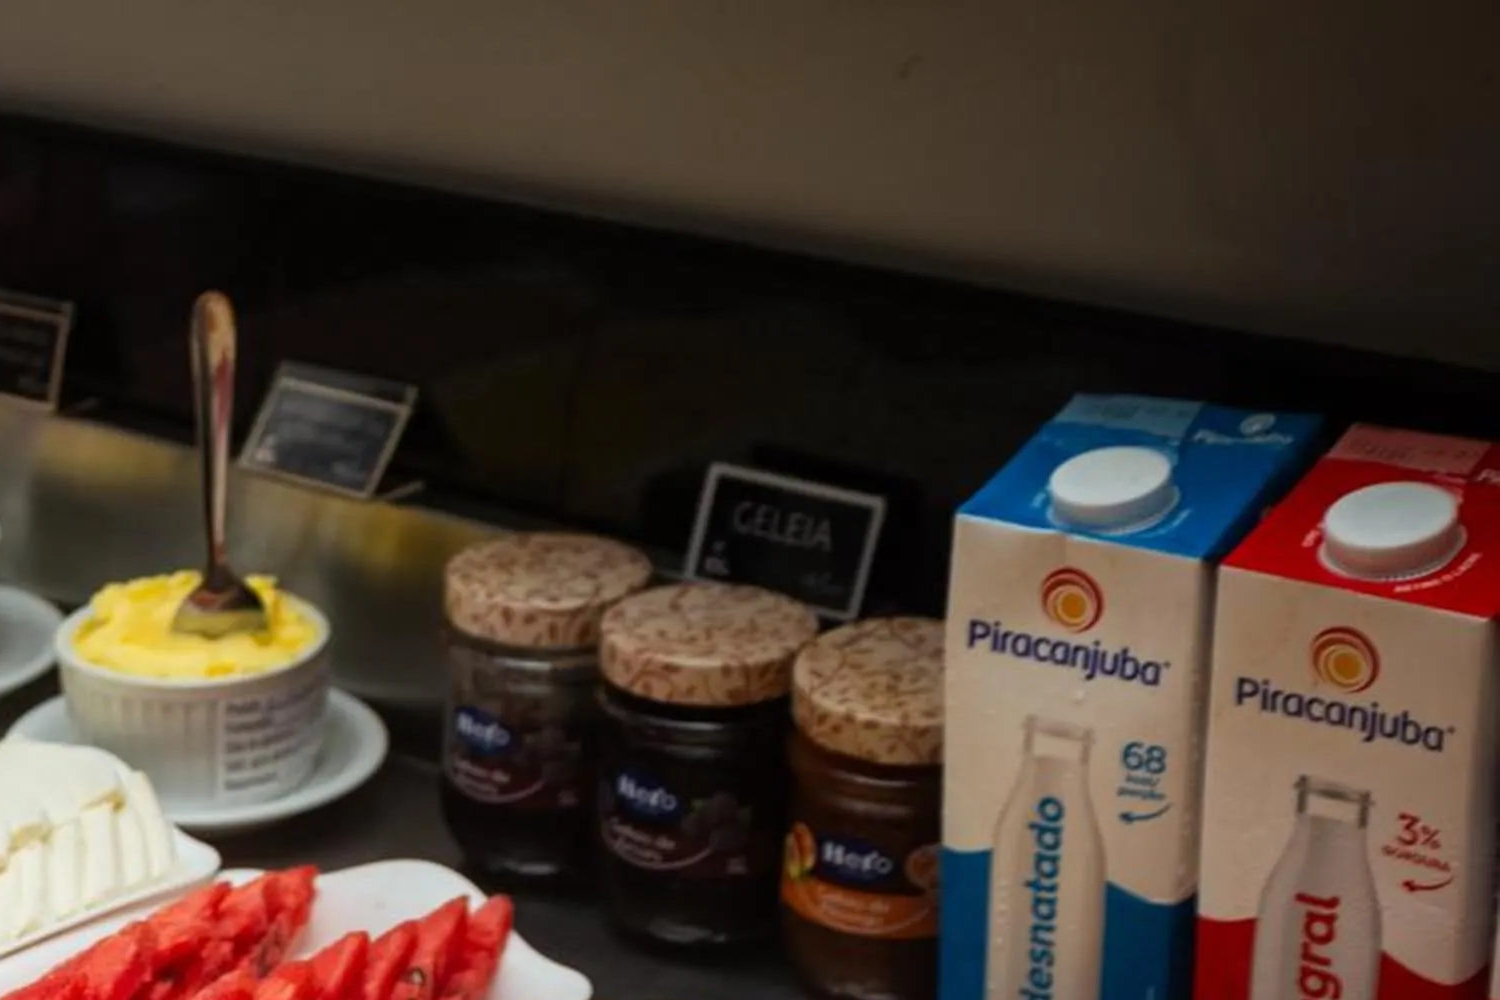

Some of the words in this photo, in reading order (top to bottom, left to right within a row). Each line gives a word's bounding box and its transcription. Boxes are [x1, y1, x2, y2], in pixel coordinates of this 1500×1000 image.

[733, 501, 832, 552] GELEIA
[967, 620, 1162, 686] Piracanjuba
[1235, 677, 1444, 751] Piracanjuba
[1123, 742, 1167, 774] 68
[617, 773, 677, 811] Hero
[1398, 812, 1441, 850] 3%
[822, 842, 893, 874] Hero
